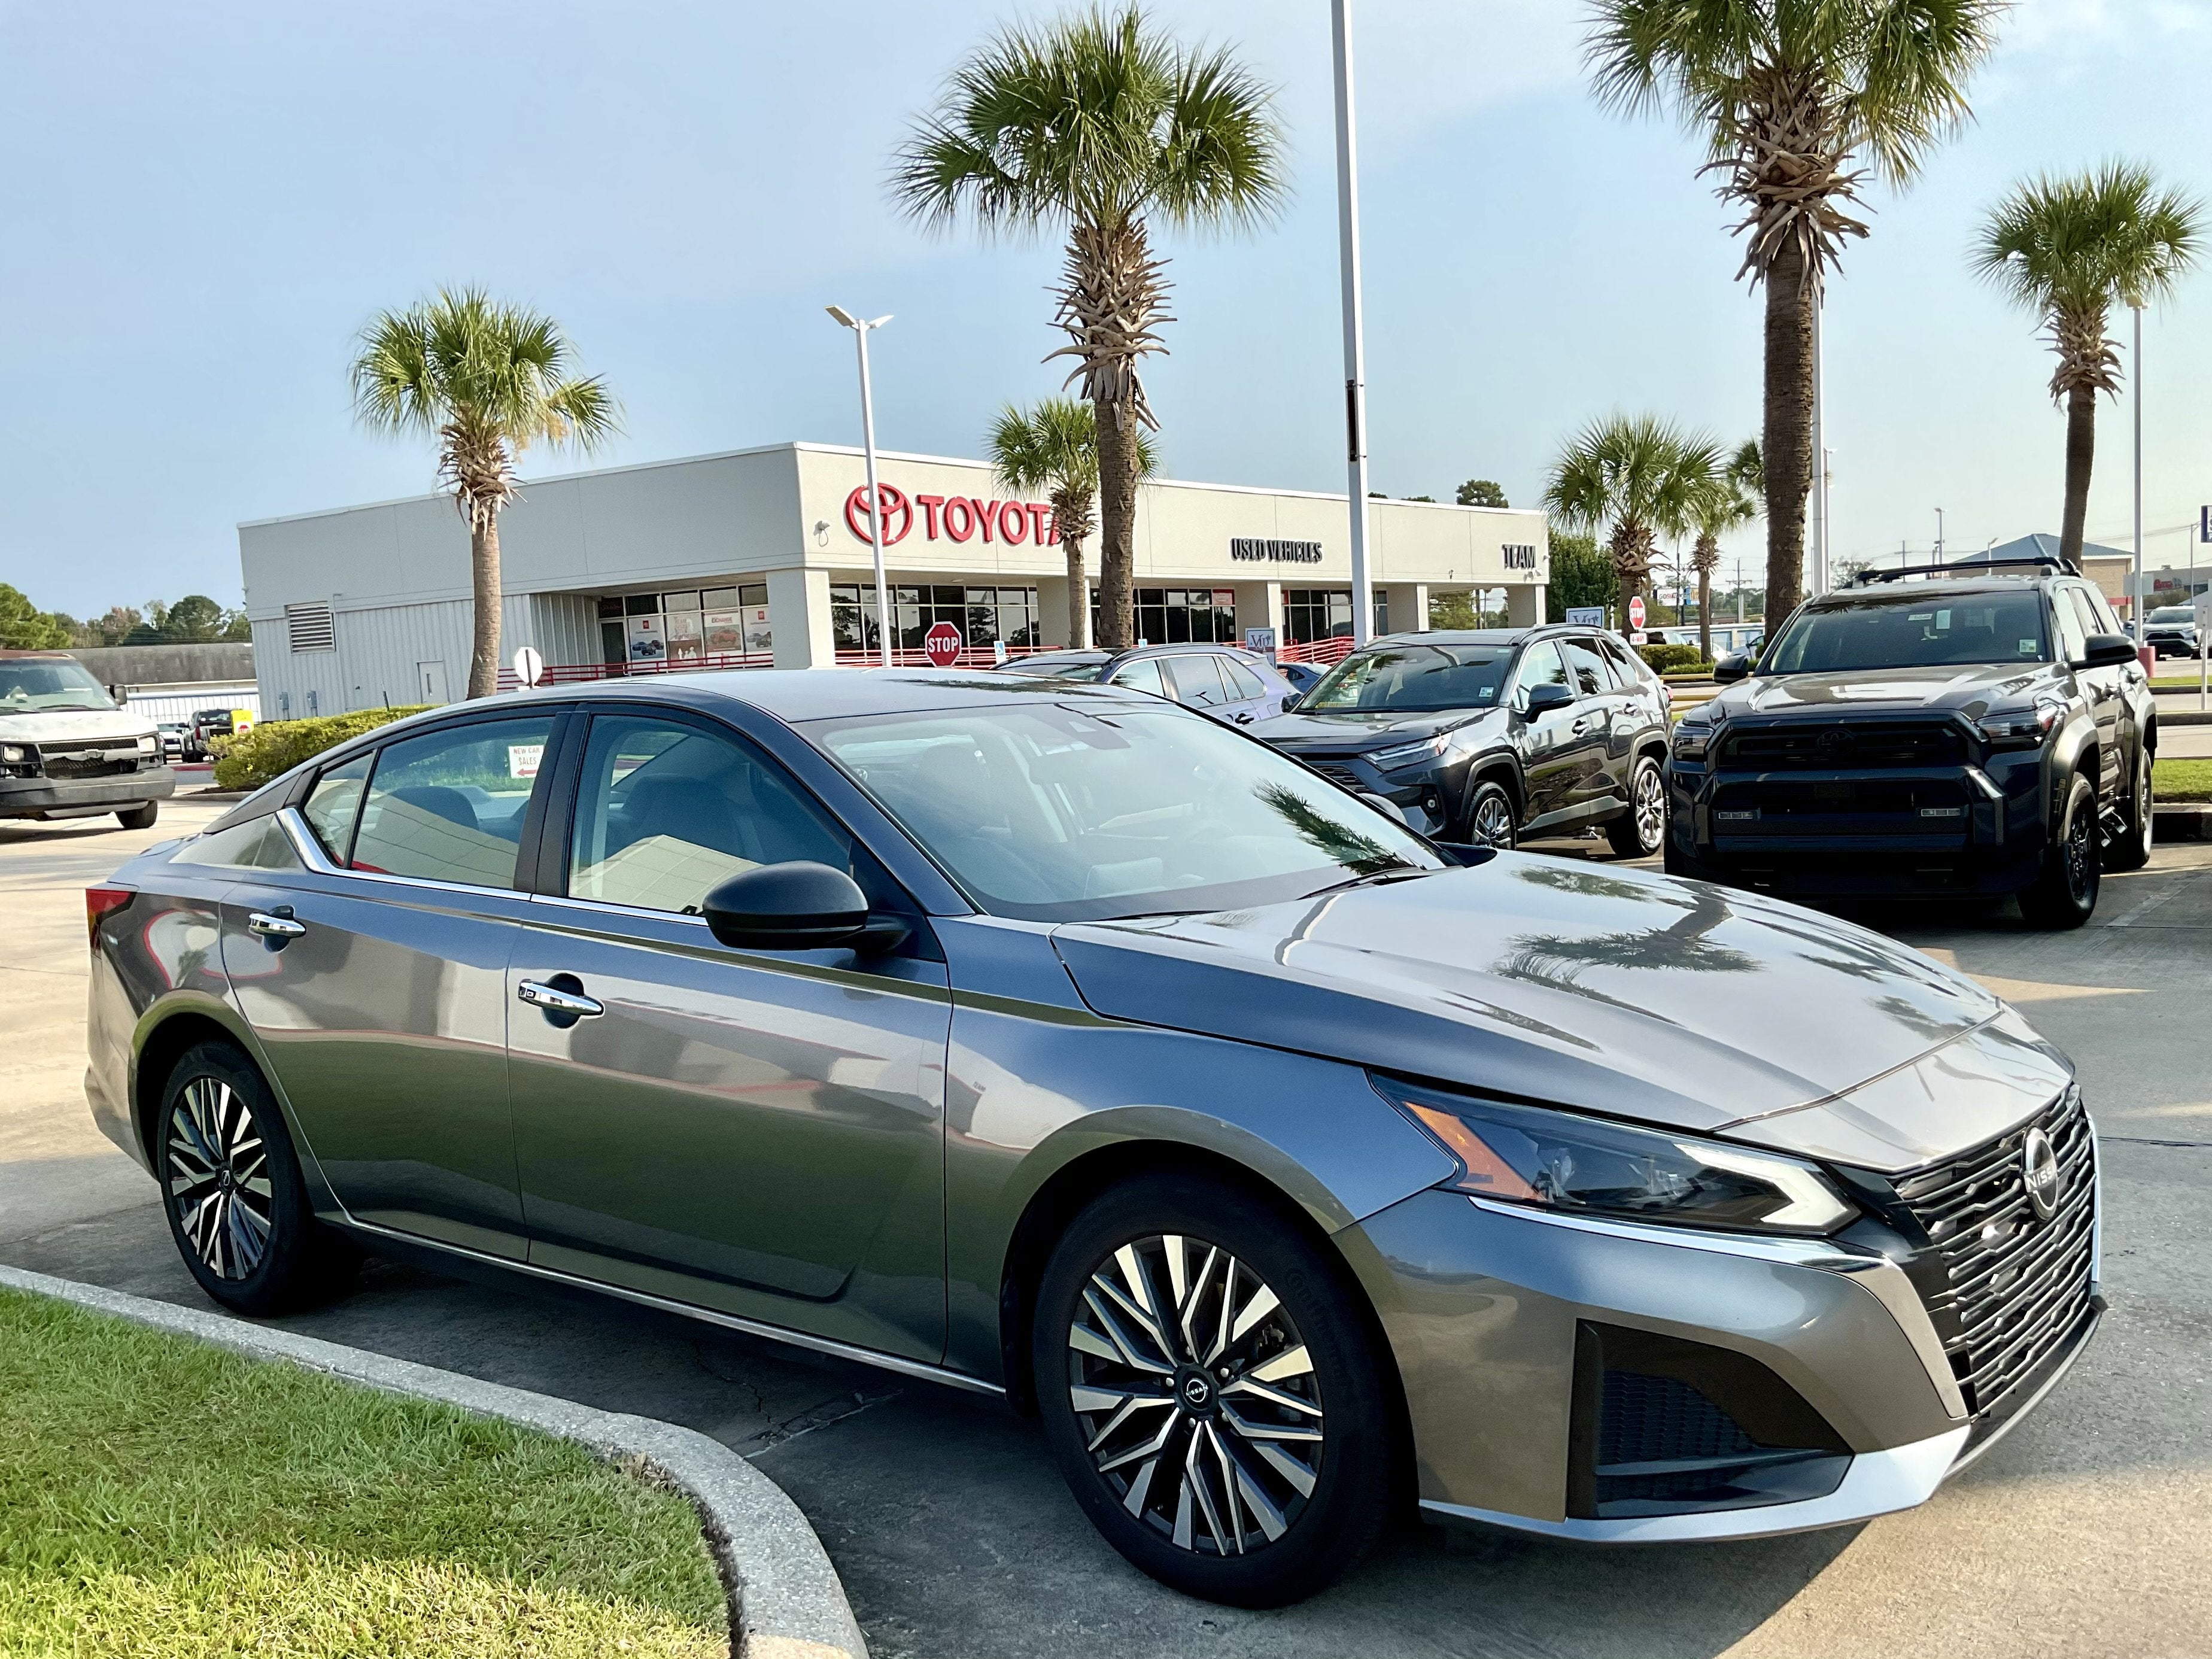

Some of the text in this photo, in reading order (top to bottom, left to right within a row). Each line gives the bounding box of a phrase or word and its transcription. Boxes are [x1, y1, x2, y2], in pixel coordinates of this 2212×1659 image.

[1230, 538, 1322, 563] USED VEHICLES
[1501, 543, 1536, 570] TEAM
[1630, 607, 1643, 619] STOP
[928, 636, 958, 653] STOP
[518, 756, 537, 765] SALES
[1186, 1384, 1209, 1397] NISSAN
